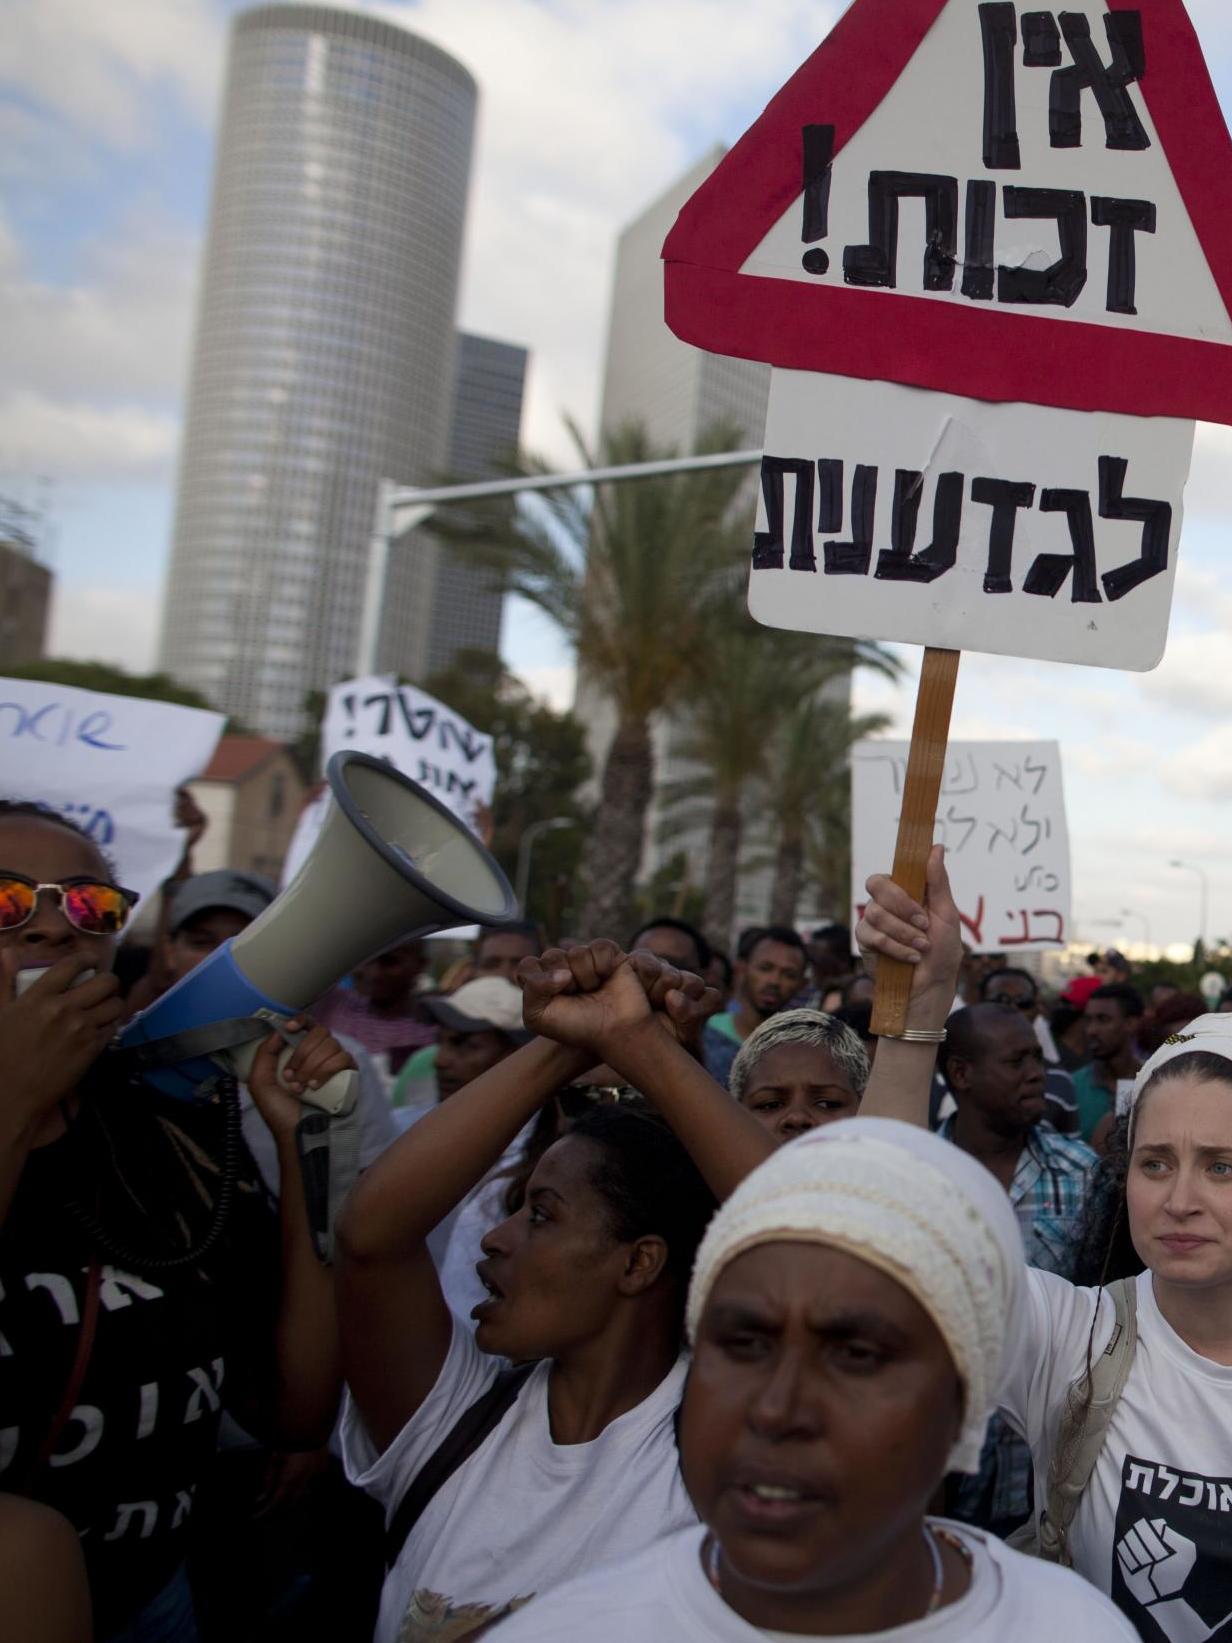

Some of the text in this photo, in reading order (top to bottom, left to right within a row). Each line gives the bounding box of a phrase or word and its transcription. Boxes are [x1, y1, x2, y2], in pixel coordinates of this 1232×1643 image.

[978, 2, 1151, 170] אין
[801, 124, 1156, 315] זכות!
[993, 755, 1047, 795] לא
[988, 804, 1051, 855] ולא
[998, 909, 1064, 945] בני
[0, 1356, 224, 1475] אוכ
